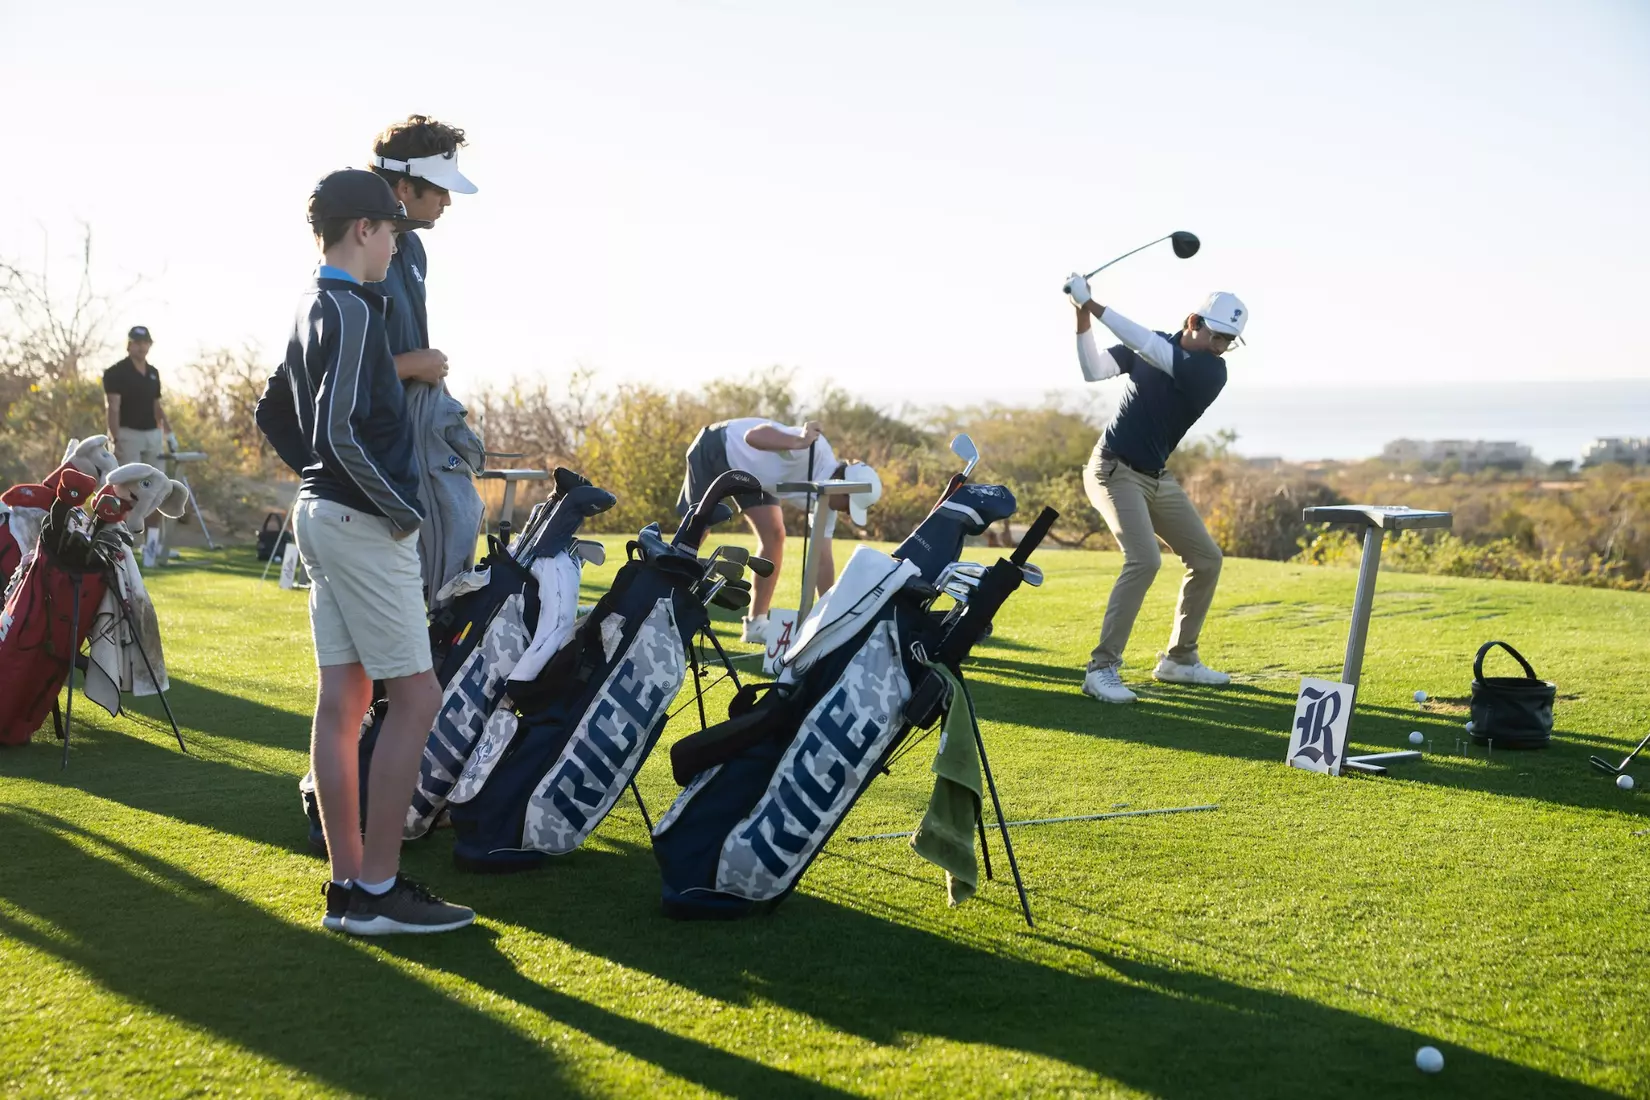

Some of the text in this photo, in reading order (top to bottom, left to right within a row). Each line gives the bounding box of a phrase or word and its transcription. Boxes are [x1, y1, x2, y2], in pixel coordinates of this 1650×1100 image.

[767, 620, 794, 659] A
[541, 658, 666, 832] RICE
[740, 686, 881, 879] RICE
[1294, 686, 1342, 767] R
